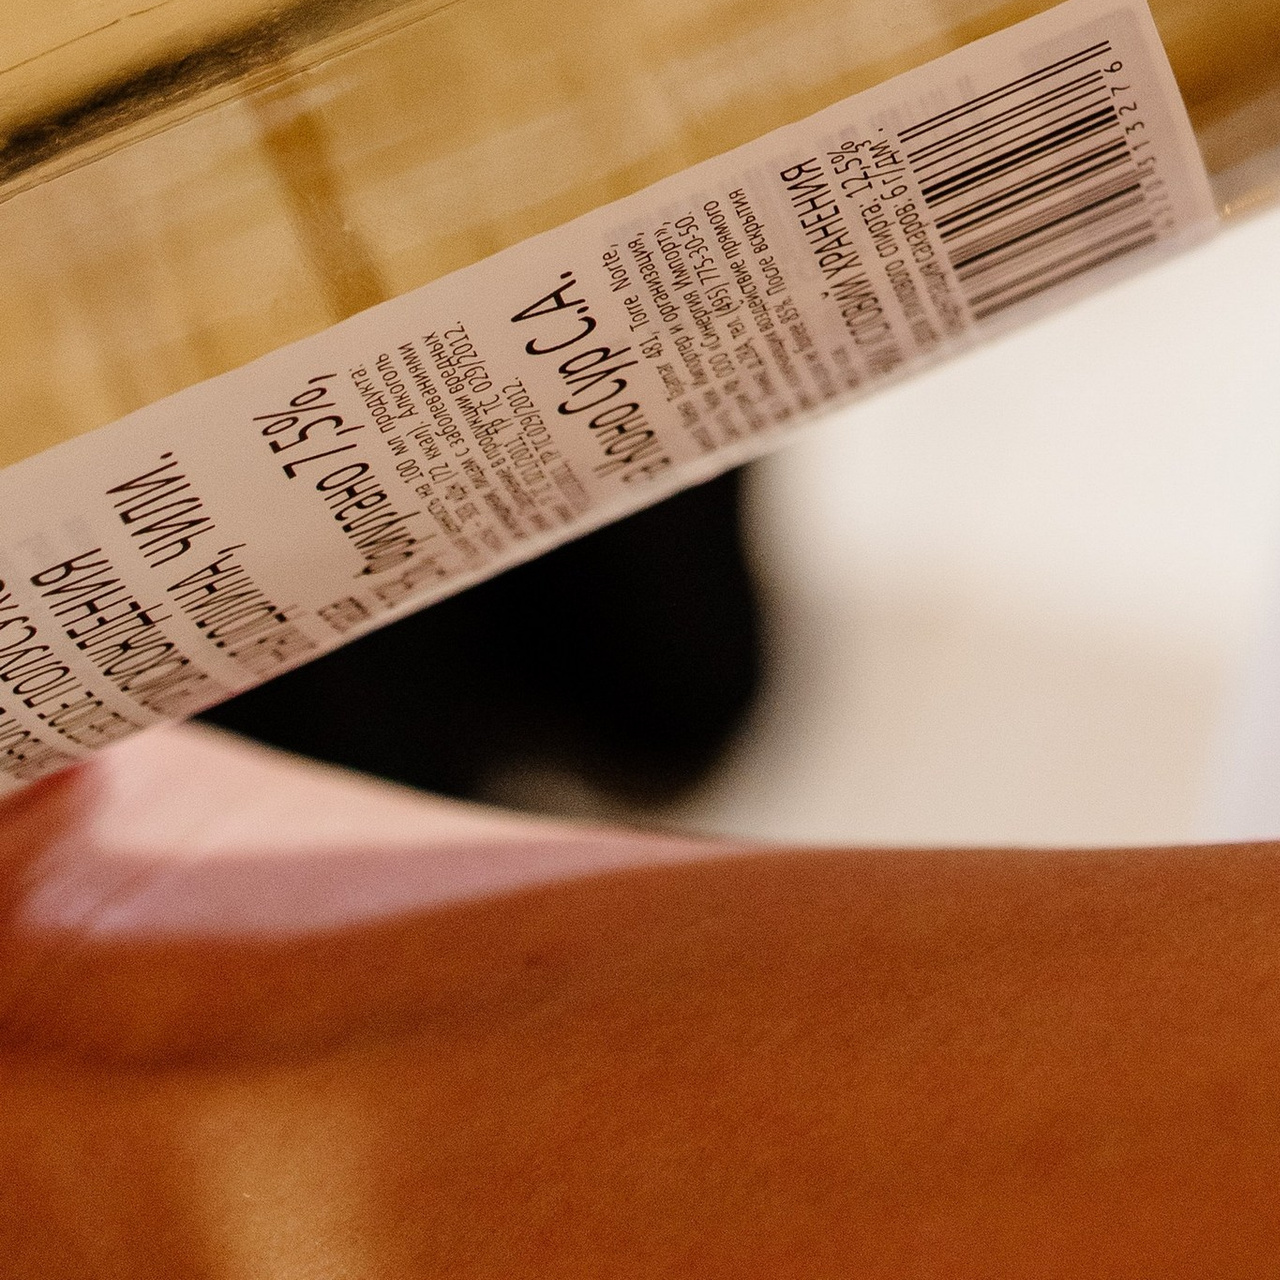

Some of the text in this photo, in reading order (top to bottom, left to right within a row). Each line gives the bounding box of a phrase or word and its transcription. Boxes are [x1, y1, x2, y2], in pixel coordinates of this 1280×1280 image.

[826, 138, 873, 199] 12,5%
[886, 183, 908, 200] 6
[673, 210, 720, 285] 775-30-50.
[702, 199, 740, 260] прямого
[727, 187, 767, 254] вскрытия
[779, 156, 861, 280] ХРАНЕНИЯ
[856, 197, 899, 259] спирта:
[892, 197, 935, 264] сахаров:
[597, 243, 632, 292] Norte,
[626, 232, 680, 322] организация,
[649, 220, 691, 290] Импорт»,
[755, 255, 786, 296] После
[510, 270, 599, 361] С.А.
[619, 294, 651, 331] Torre
[679, 291, 723, 353] «Синергия
[704, 283, 737, 318] (495)
[728, 258, 774, 332] воздействие
[441, 320, 493, 393] 029/2012.
[638, 329, 666, 361] 481,
[668, 322, 685, 335] и
[368, 352, 418, 422] Алкоголь
[422, 330, 469, 393] вредных
[555, 342, 637, 419] Сур
[253, 373, 363, 479] 7,5%,
[349, 362, 404, 433] продукта:
[398, 340, 464, 449] заболеваниями
[455, 391, 502, 460] продукции
[499, 375, 546, 438] 029/2012.
[385, 434, 409, 456] мл
[406, 421, 443, 461] ккал).
[455, 446, 469, 457] с
[586, 398, 661, 477] Коно
[395, 457, 423, 484] 100
[414, 482, 434, 499] на
[429, 461, 456, 485] (72
[105, 450, 215, 568] ЧИЛИ.
[166, 543, 306, 652] ДОЛИНА,
